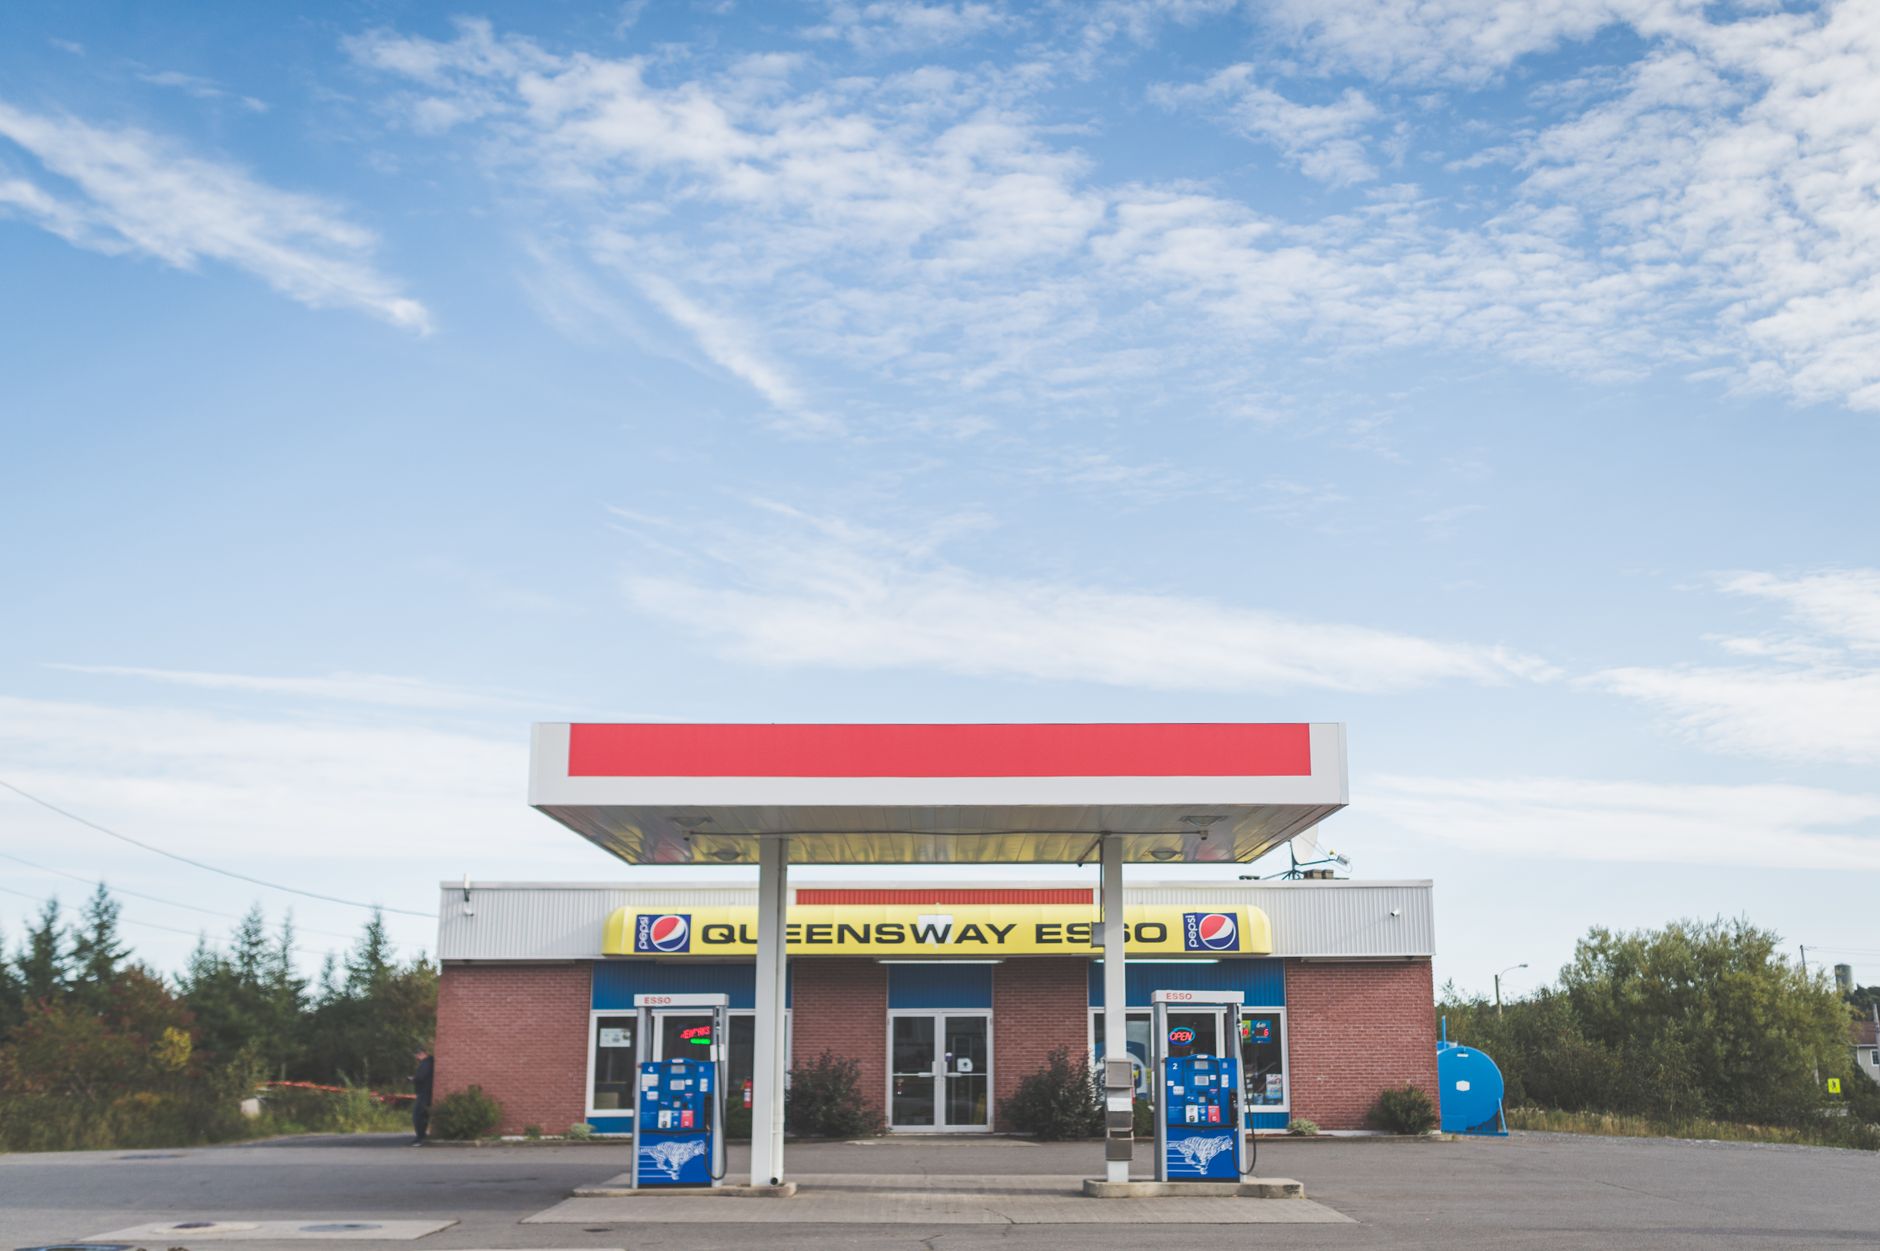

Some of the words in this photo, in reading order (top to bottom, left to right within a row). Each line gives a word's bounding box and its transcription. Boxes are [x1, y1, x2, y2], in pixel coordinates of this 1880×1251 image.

[638, 916, 650, 950] pepsi
[1035, 922, 1167, 944] ESO
[1185, 914, 1200, 948] pepsi
[643, 996, 672, 1005] ESSO
[1166, 992, 1193, 1000] ESSO
[1169, 1031, 1193, 1042] OPEN
[1172, 1062, 1179, 1071] 2
